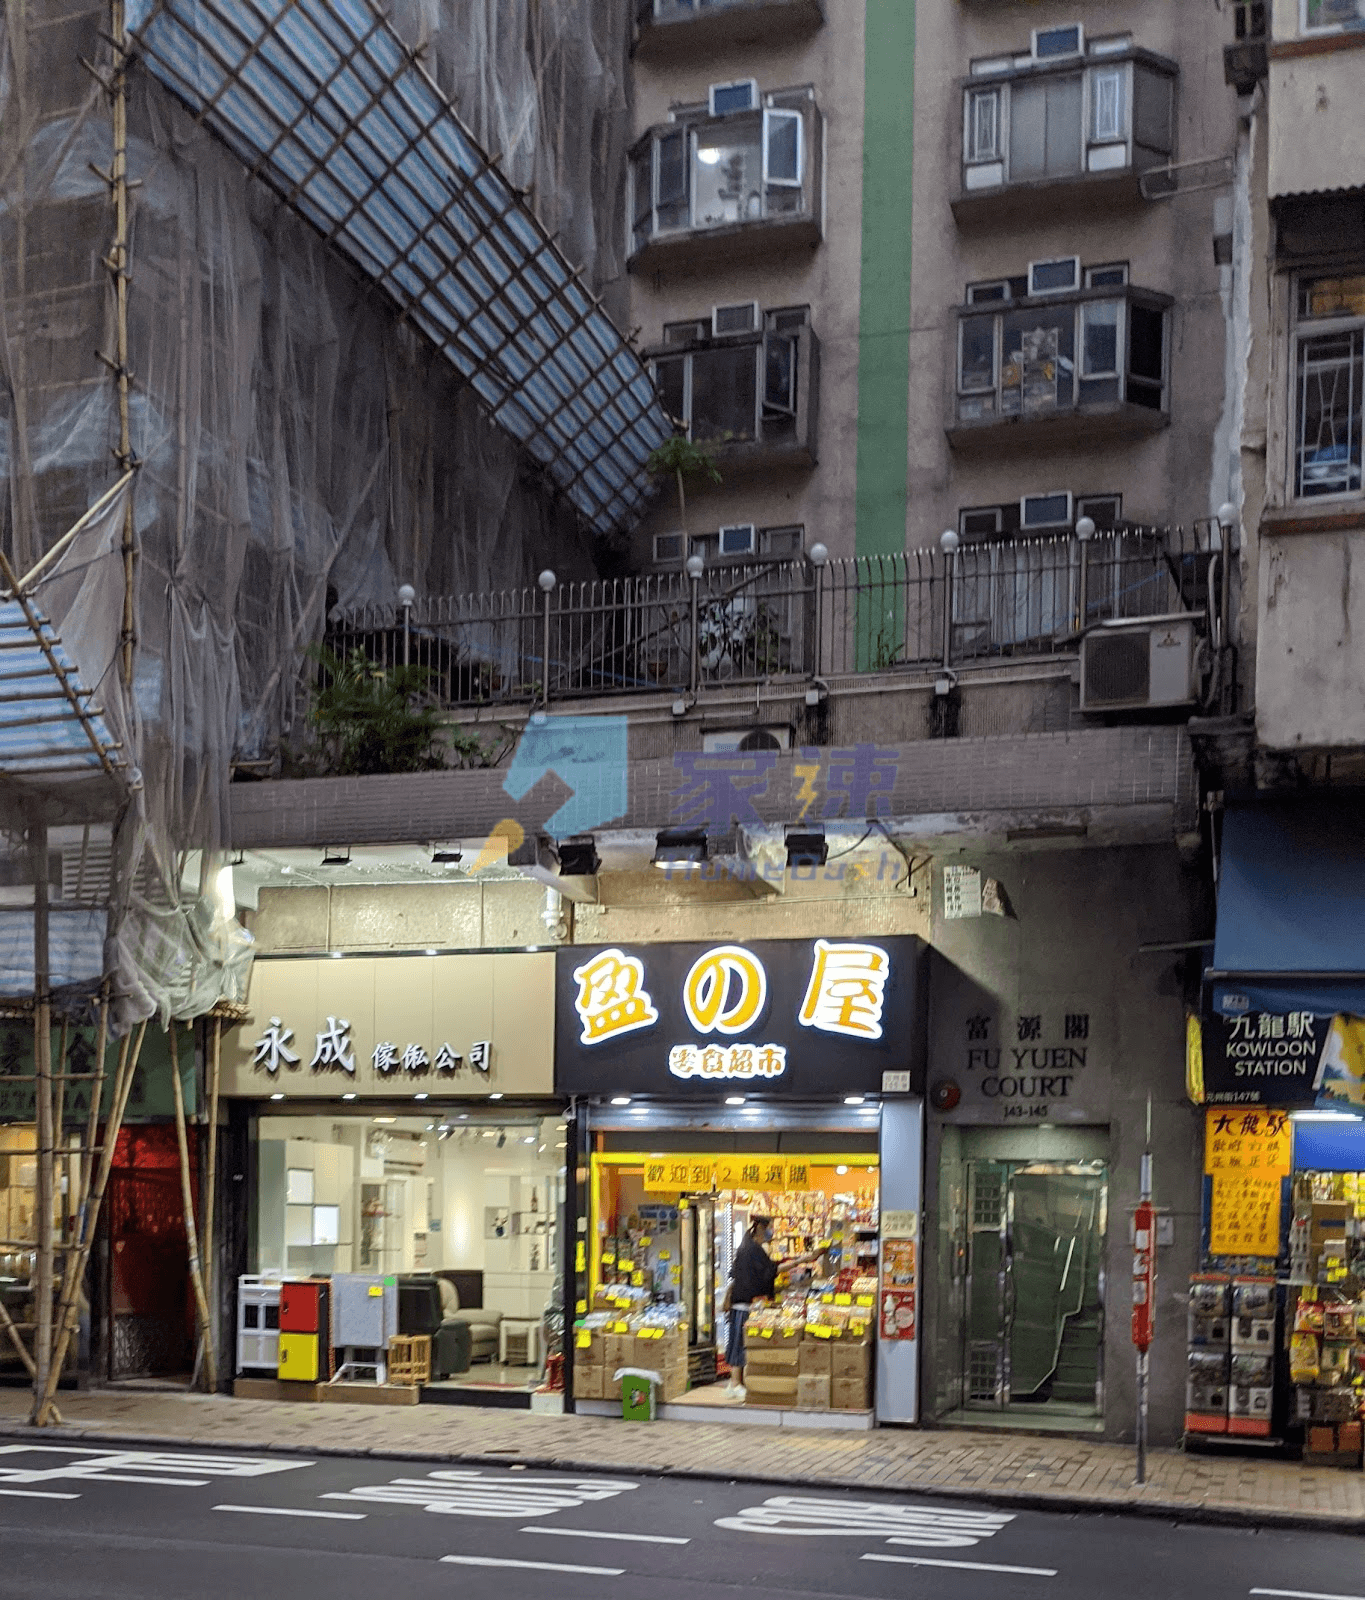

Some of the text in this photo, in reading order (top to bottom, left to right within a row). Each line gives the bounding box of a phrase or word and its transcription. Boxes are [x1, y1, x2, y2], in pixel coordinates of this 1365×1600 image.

[574, 940, 889, 1044] 盈の屋
[1229, 1011, 1314, 1039] 九龍駅
[669, 1043, 786, 1078] 零食超市
[967, 1047, 1088, 1070] FU YUEN
[1226, 1040, 1316, 1058] KOWLOON
[1234, 1059, 1307, 1076] STATION
[981, 1076, 1074, 1098] COURT
[1003, 1105, 1048, 1118] 143-145
[713, 1495, 1018, 1547] BUS
